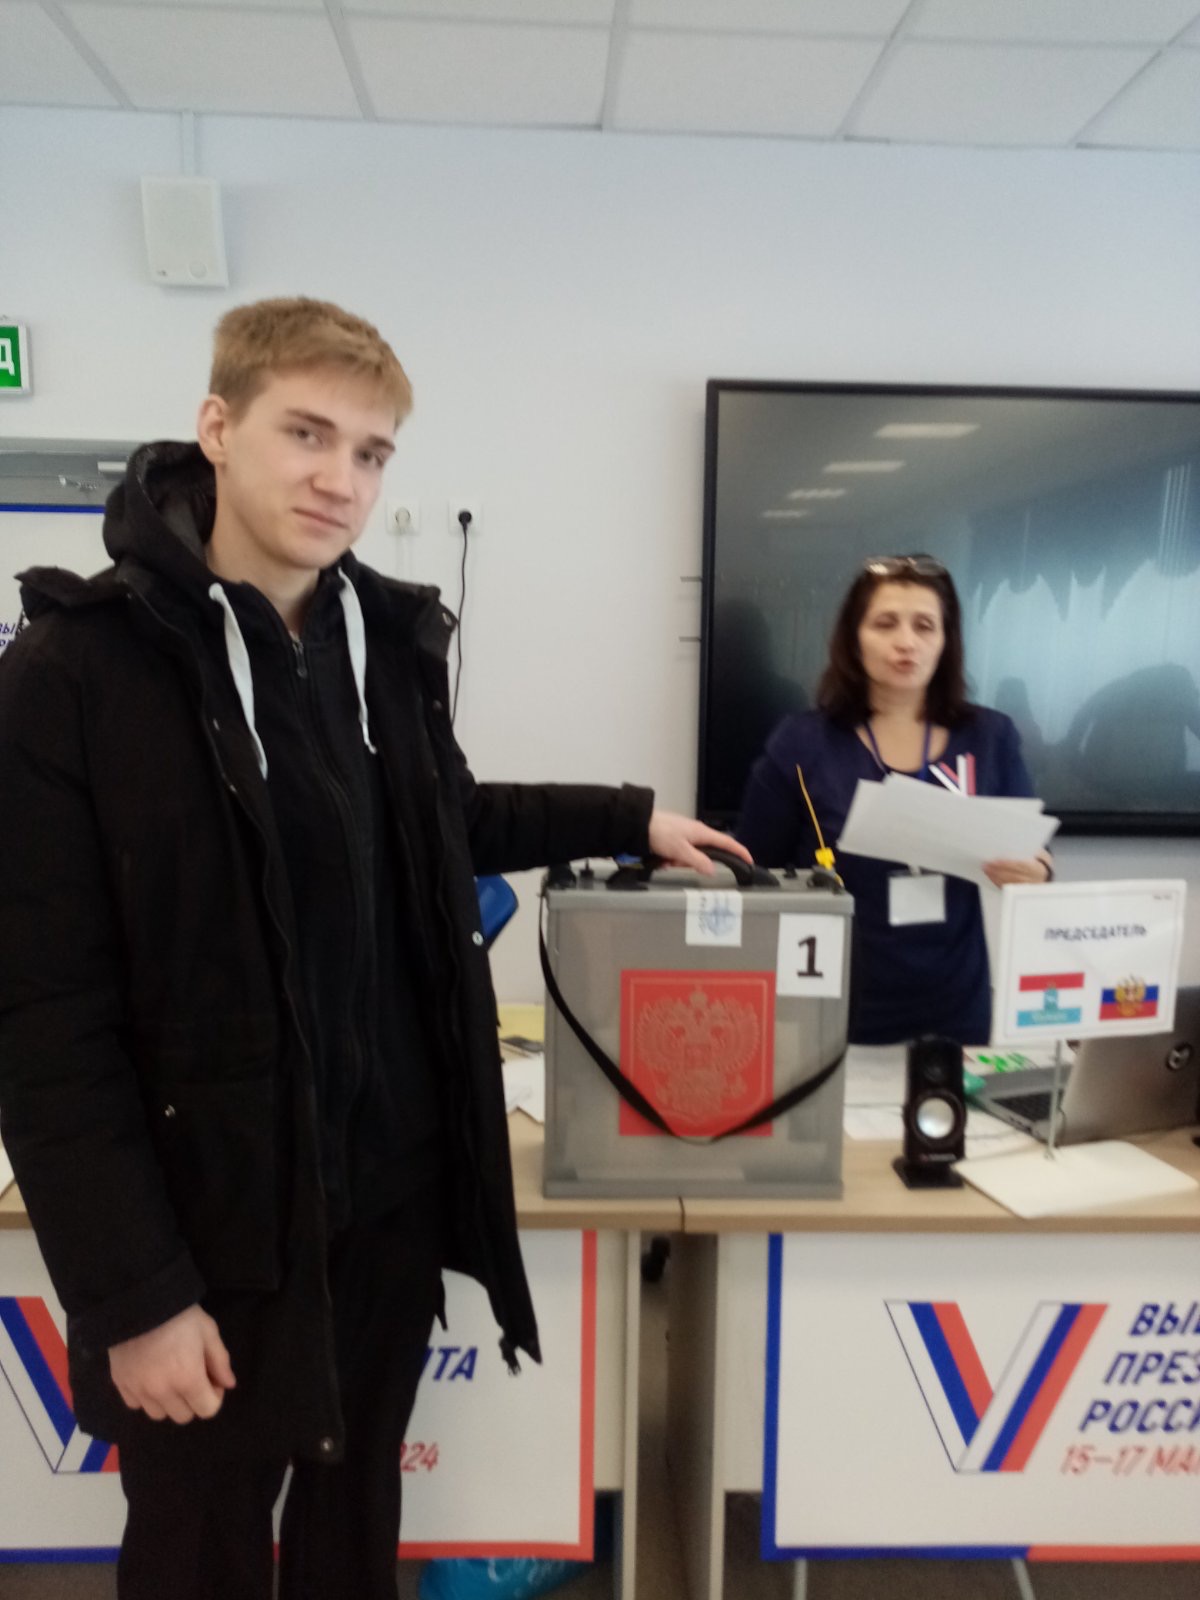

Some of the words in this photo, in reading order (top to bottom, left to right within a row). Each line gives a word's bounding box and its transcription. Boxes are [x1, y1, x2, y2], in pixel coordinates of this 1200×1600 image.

[1044, 923, 1147, 941] ПРЕДСЕДАТЕЛЬ
[796, 935, 823, 979] 1
[1130, 1302, 1200, 1335] ВЫ
[1145, 1444, 1200, 1475] МА
